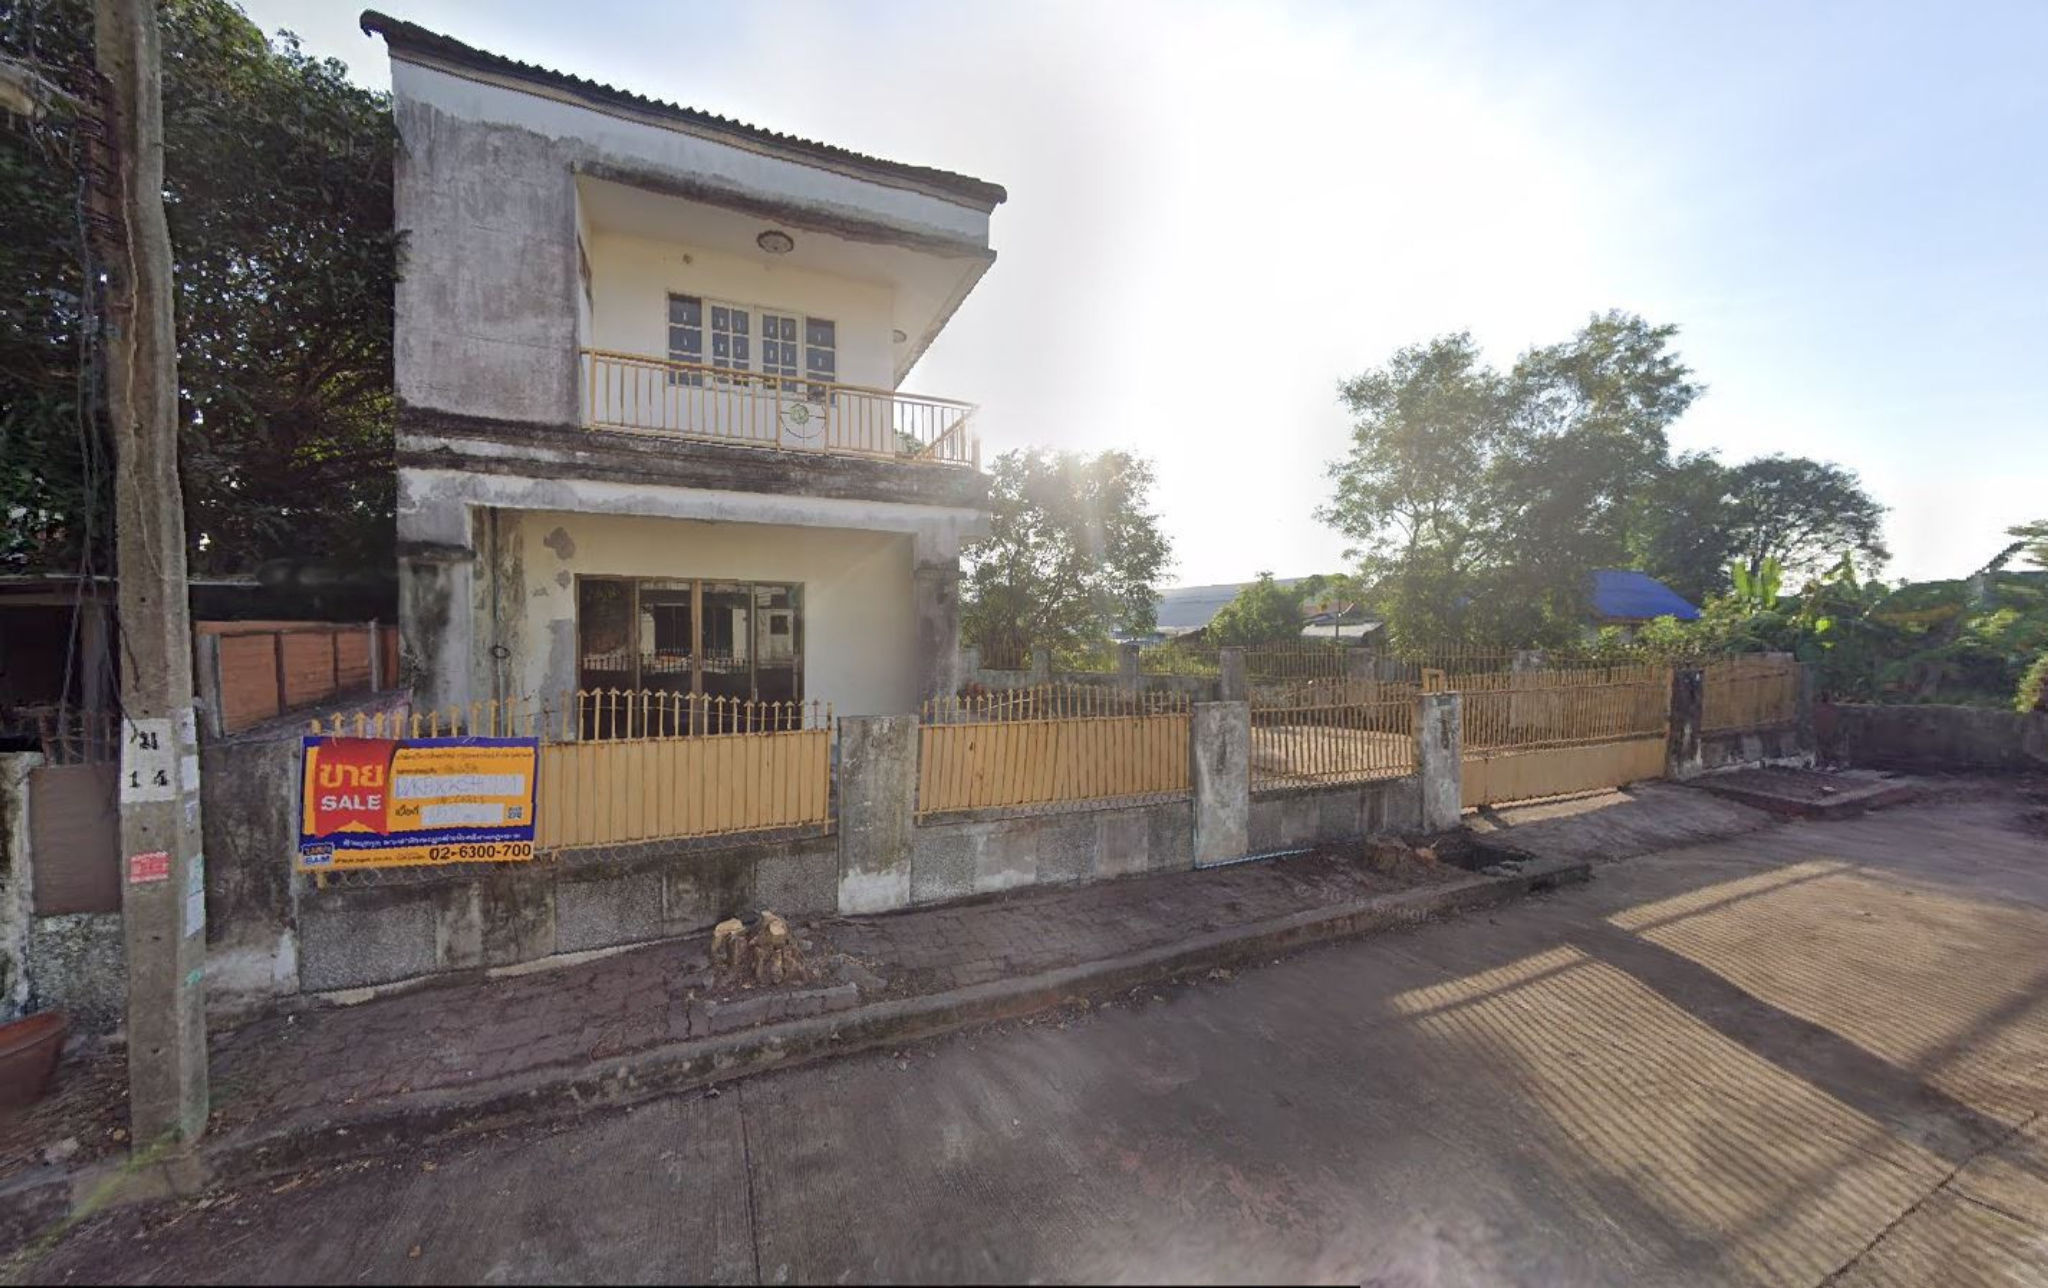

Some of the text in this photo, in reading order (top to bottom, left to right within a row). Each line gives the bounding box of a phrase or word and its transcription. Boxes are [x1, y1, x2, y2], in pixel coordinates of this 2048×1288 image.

[319, 764, 384, 788] ขาย
[320, 794, 382, 811] SALE
[429, 843, 532, 861] 02-6300-700
